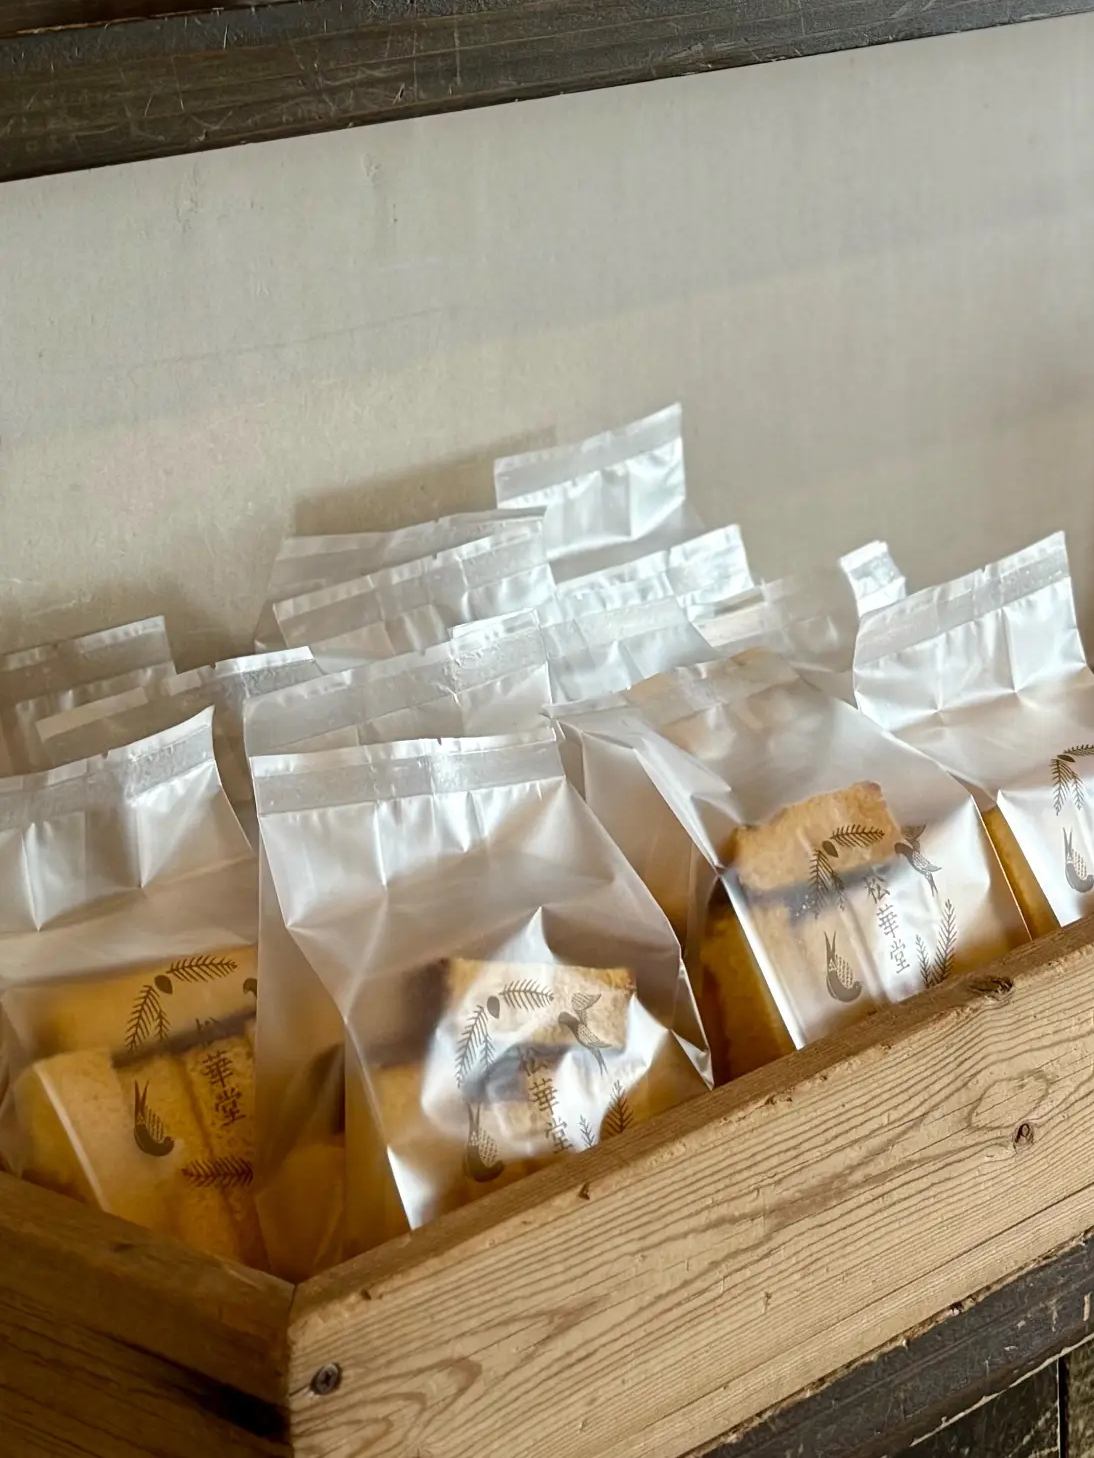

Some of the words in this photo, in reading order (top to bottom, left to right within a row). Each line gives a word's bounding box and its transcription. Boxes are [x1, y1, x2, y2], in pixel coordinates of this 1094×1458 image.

[863, 868, 910, 975] 松華堂
[517, 1045, 574, 1155] 松華堂
